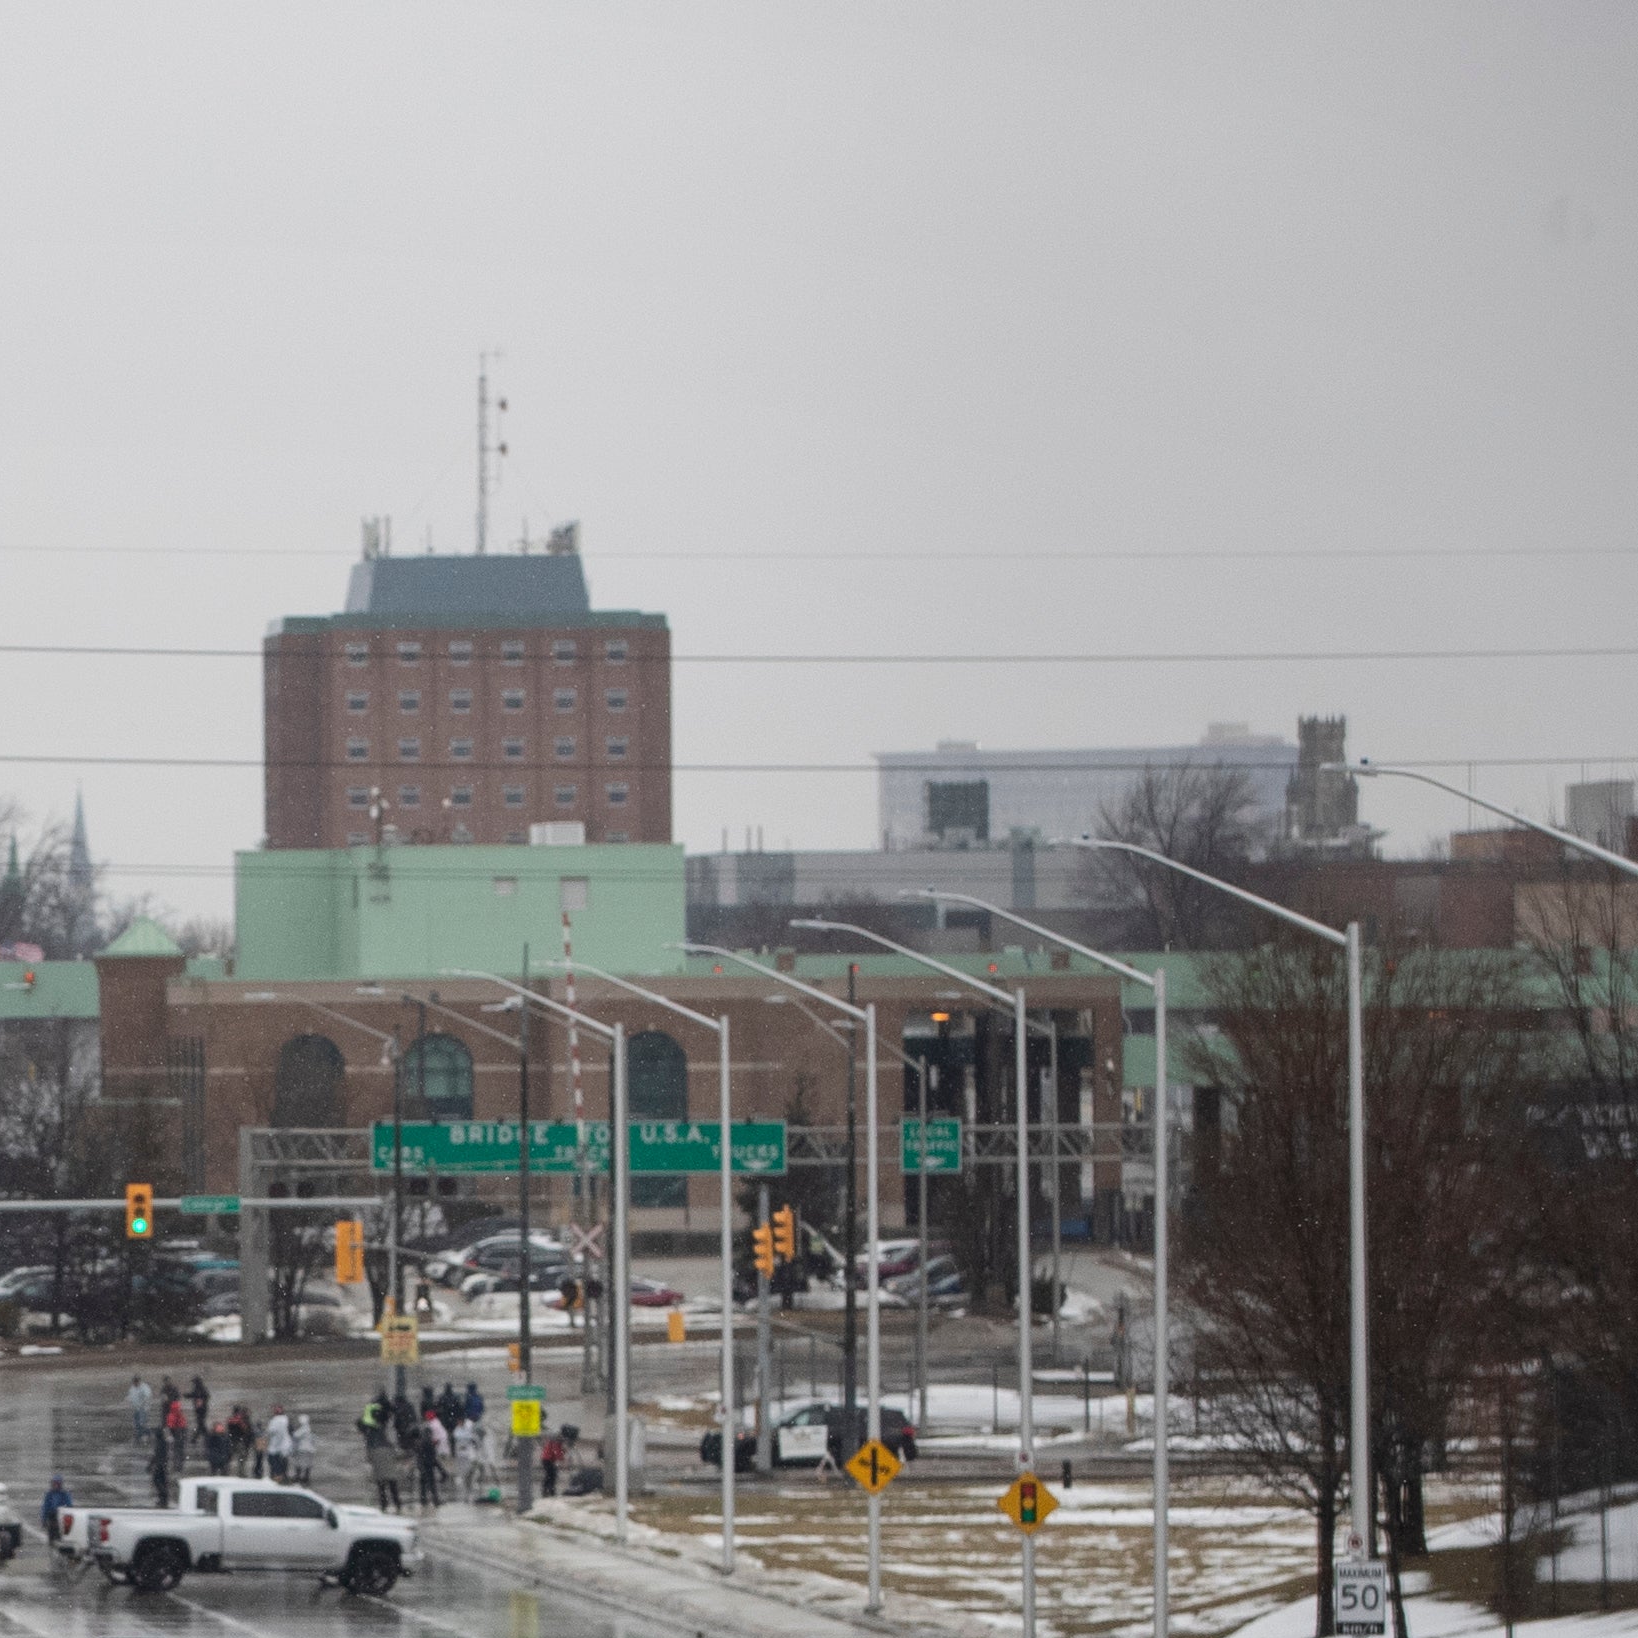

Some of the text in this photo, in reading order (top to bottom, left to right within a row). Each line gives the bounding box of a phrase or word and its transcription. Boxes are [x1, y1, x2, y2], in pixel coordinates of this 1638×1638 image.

[640, 1124, 710, 1144] U.S.A.
[711, 1145, 779, 1159] TUCKS
[1341, 1583, 1379, 1611] 50
